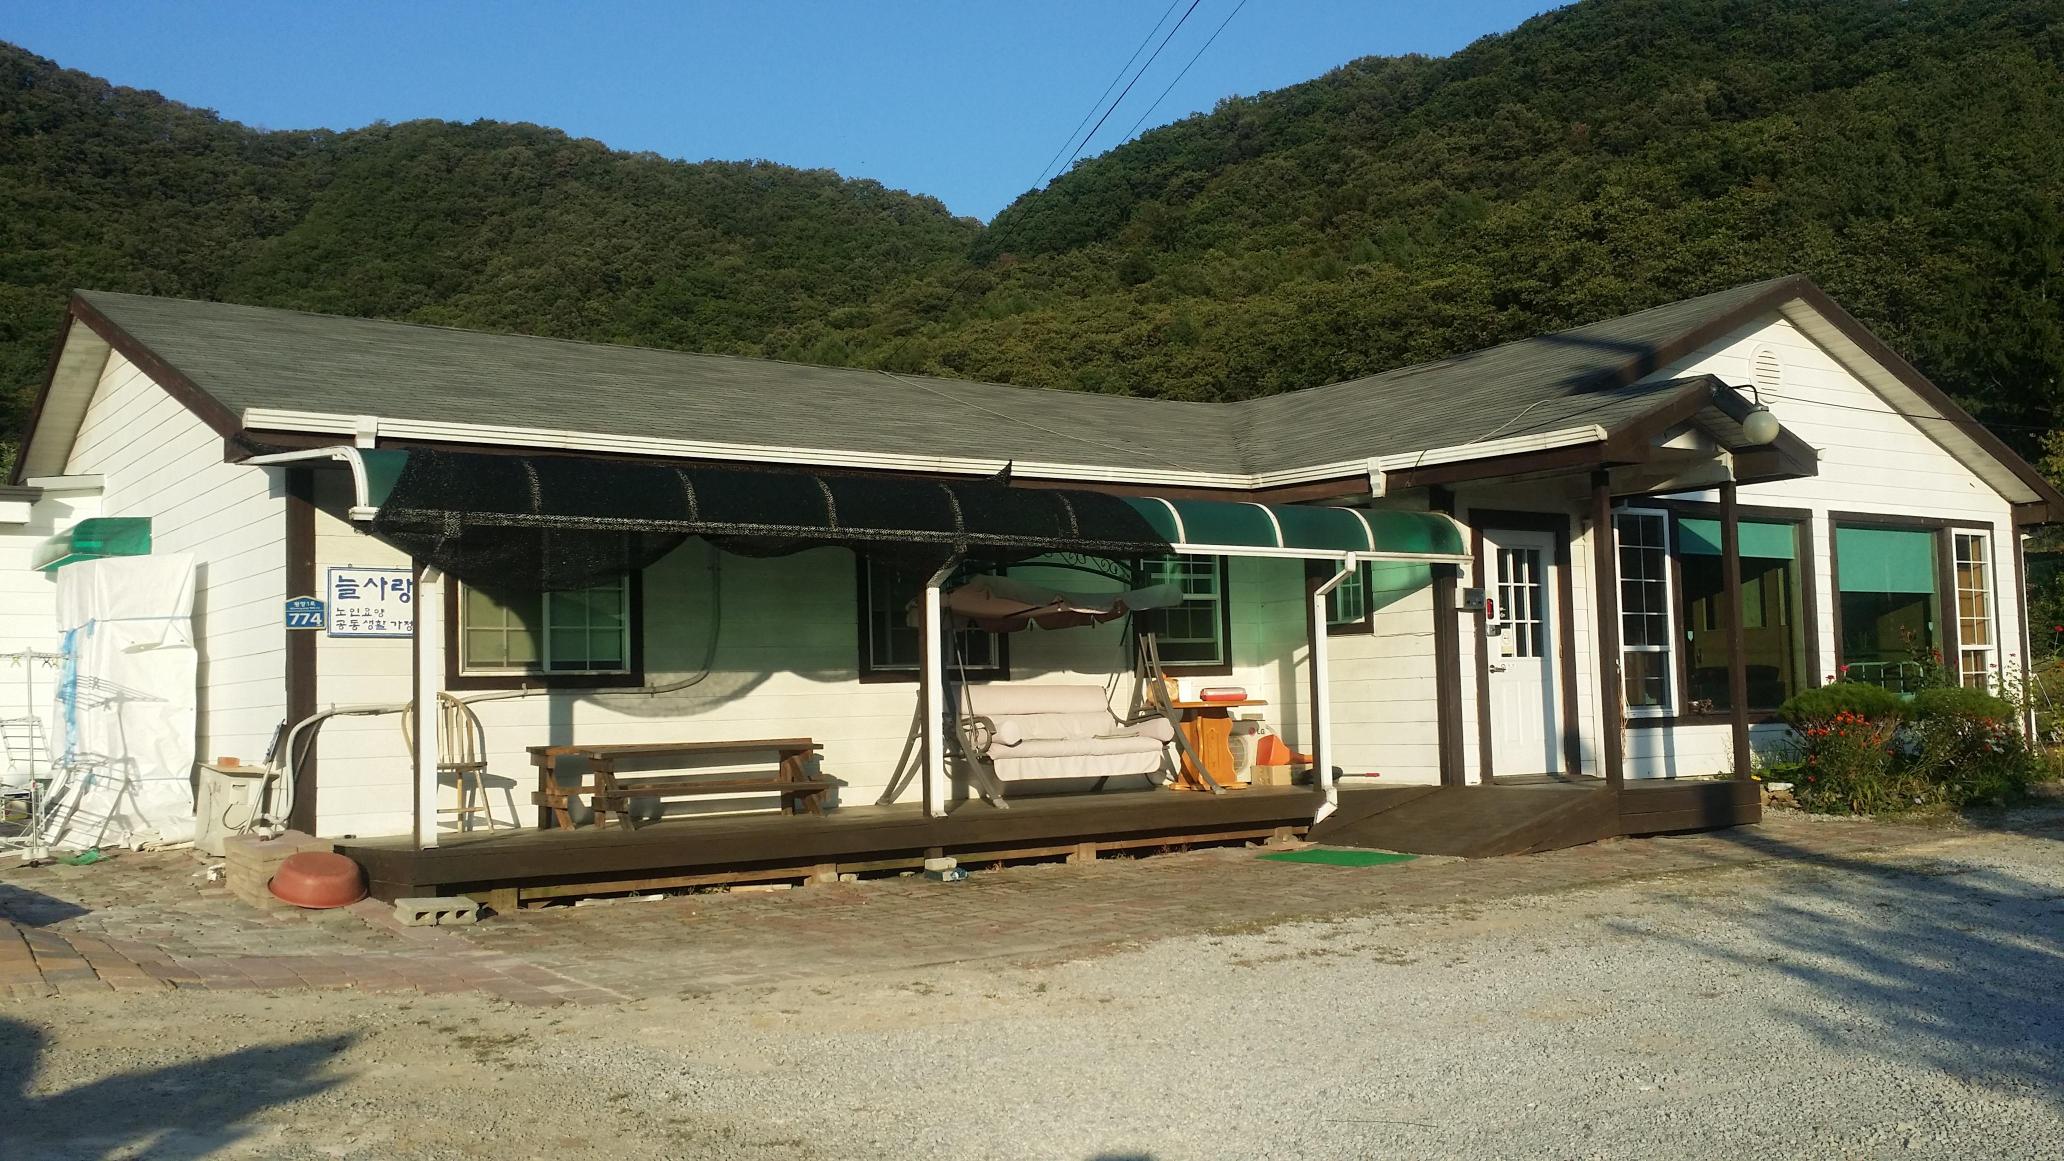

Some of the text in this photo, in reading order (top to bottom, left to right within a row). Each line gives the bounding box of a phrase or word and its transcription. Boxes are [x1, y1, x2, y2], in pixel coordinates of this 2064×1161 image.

[335, 575, 413, 603] 늘사랑
[335, 607, 385, 618] 노인요양
[288, 613, 322, 625] 774
